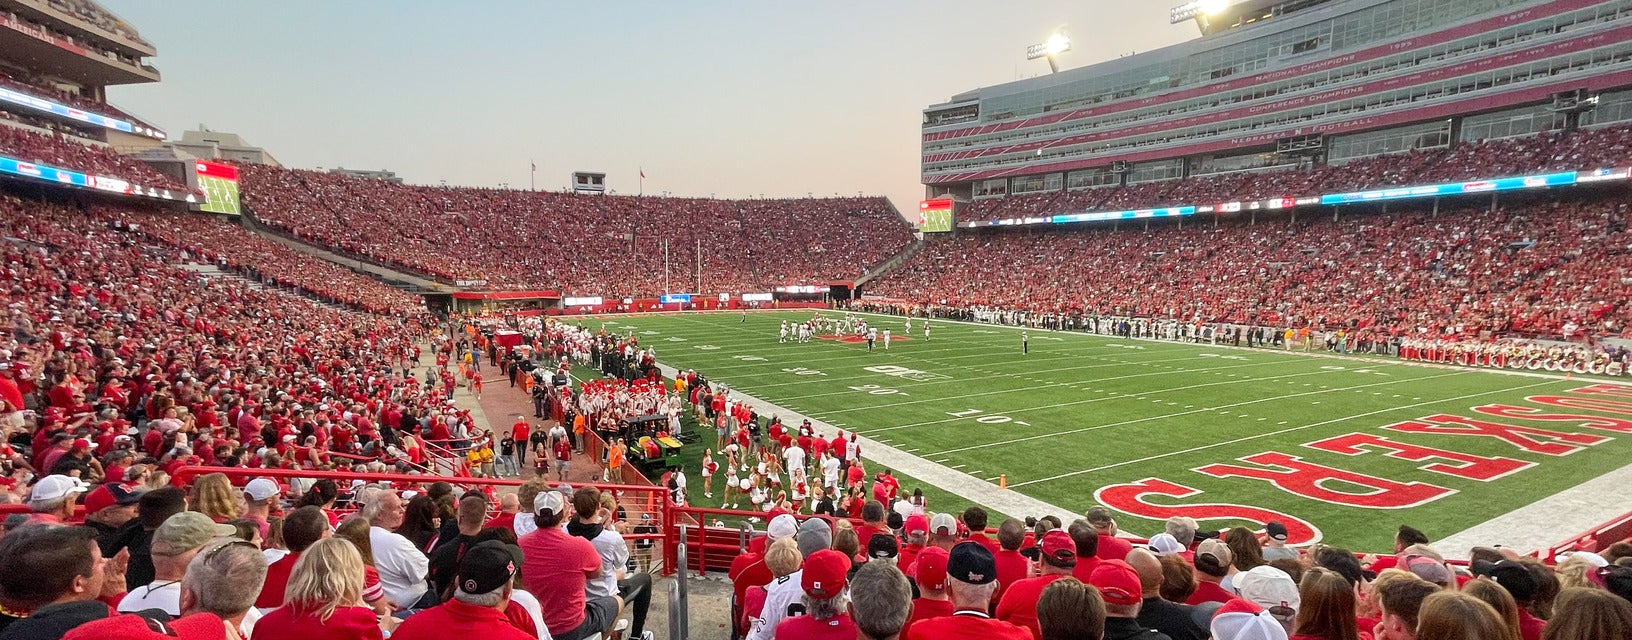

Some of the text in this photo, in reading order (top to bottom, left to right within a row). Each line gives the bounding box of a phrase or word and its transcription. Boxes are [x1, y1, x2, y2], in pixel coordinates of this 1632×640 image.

[1255, 69, 1298, 82] NATIONAL
[1301, 55, 1356, 71] CHAMPIONS
[1504, 11, 1531, 23] 1997
[1250, 98, 1306, 113] CONFERENCE
[1309, 86, 1364, 102] CHAMPIONS
[1231, 132, 1287, 144] NEBRASKA
[1312, 118, 1373, 133] FOOTBALL
[848, 384, 898, 395] 20
[945, 408, 1013, 424] 10
[1093, 383, 1632, 550] SKERS
